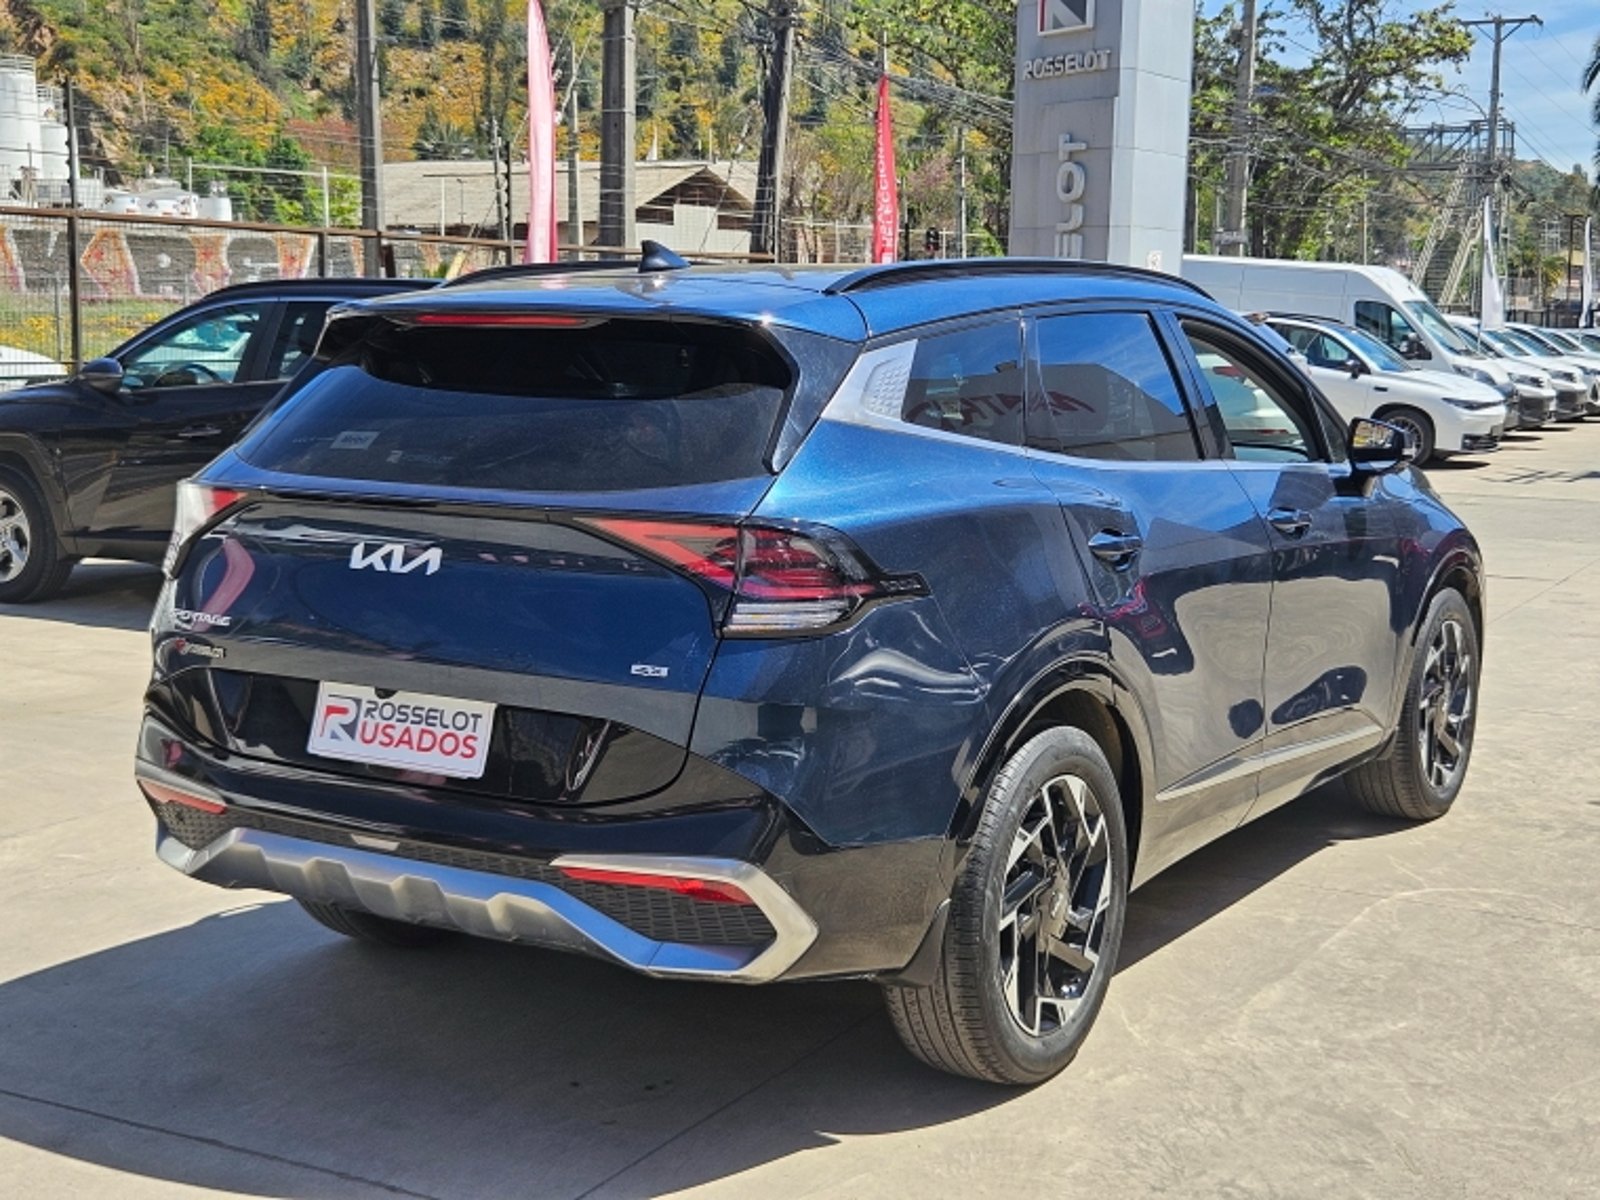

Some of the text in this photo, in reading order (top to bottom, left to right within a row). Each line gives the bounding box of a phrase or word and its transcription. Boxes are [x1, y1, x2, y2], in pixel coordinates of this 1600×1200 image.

[1022, 50, 1111, 80] ROSSELOT
[349, 541, 442, 575] KIA
[171, 608, 232, 626] ORTAGE
[363, 700, 483, 733] ROSSELOT
[360, 721, 478, 759] USADOS
